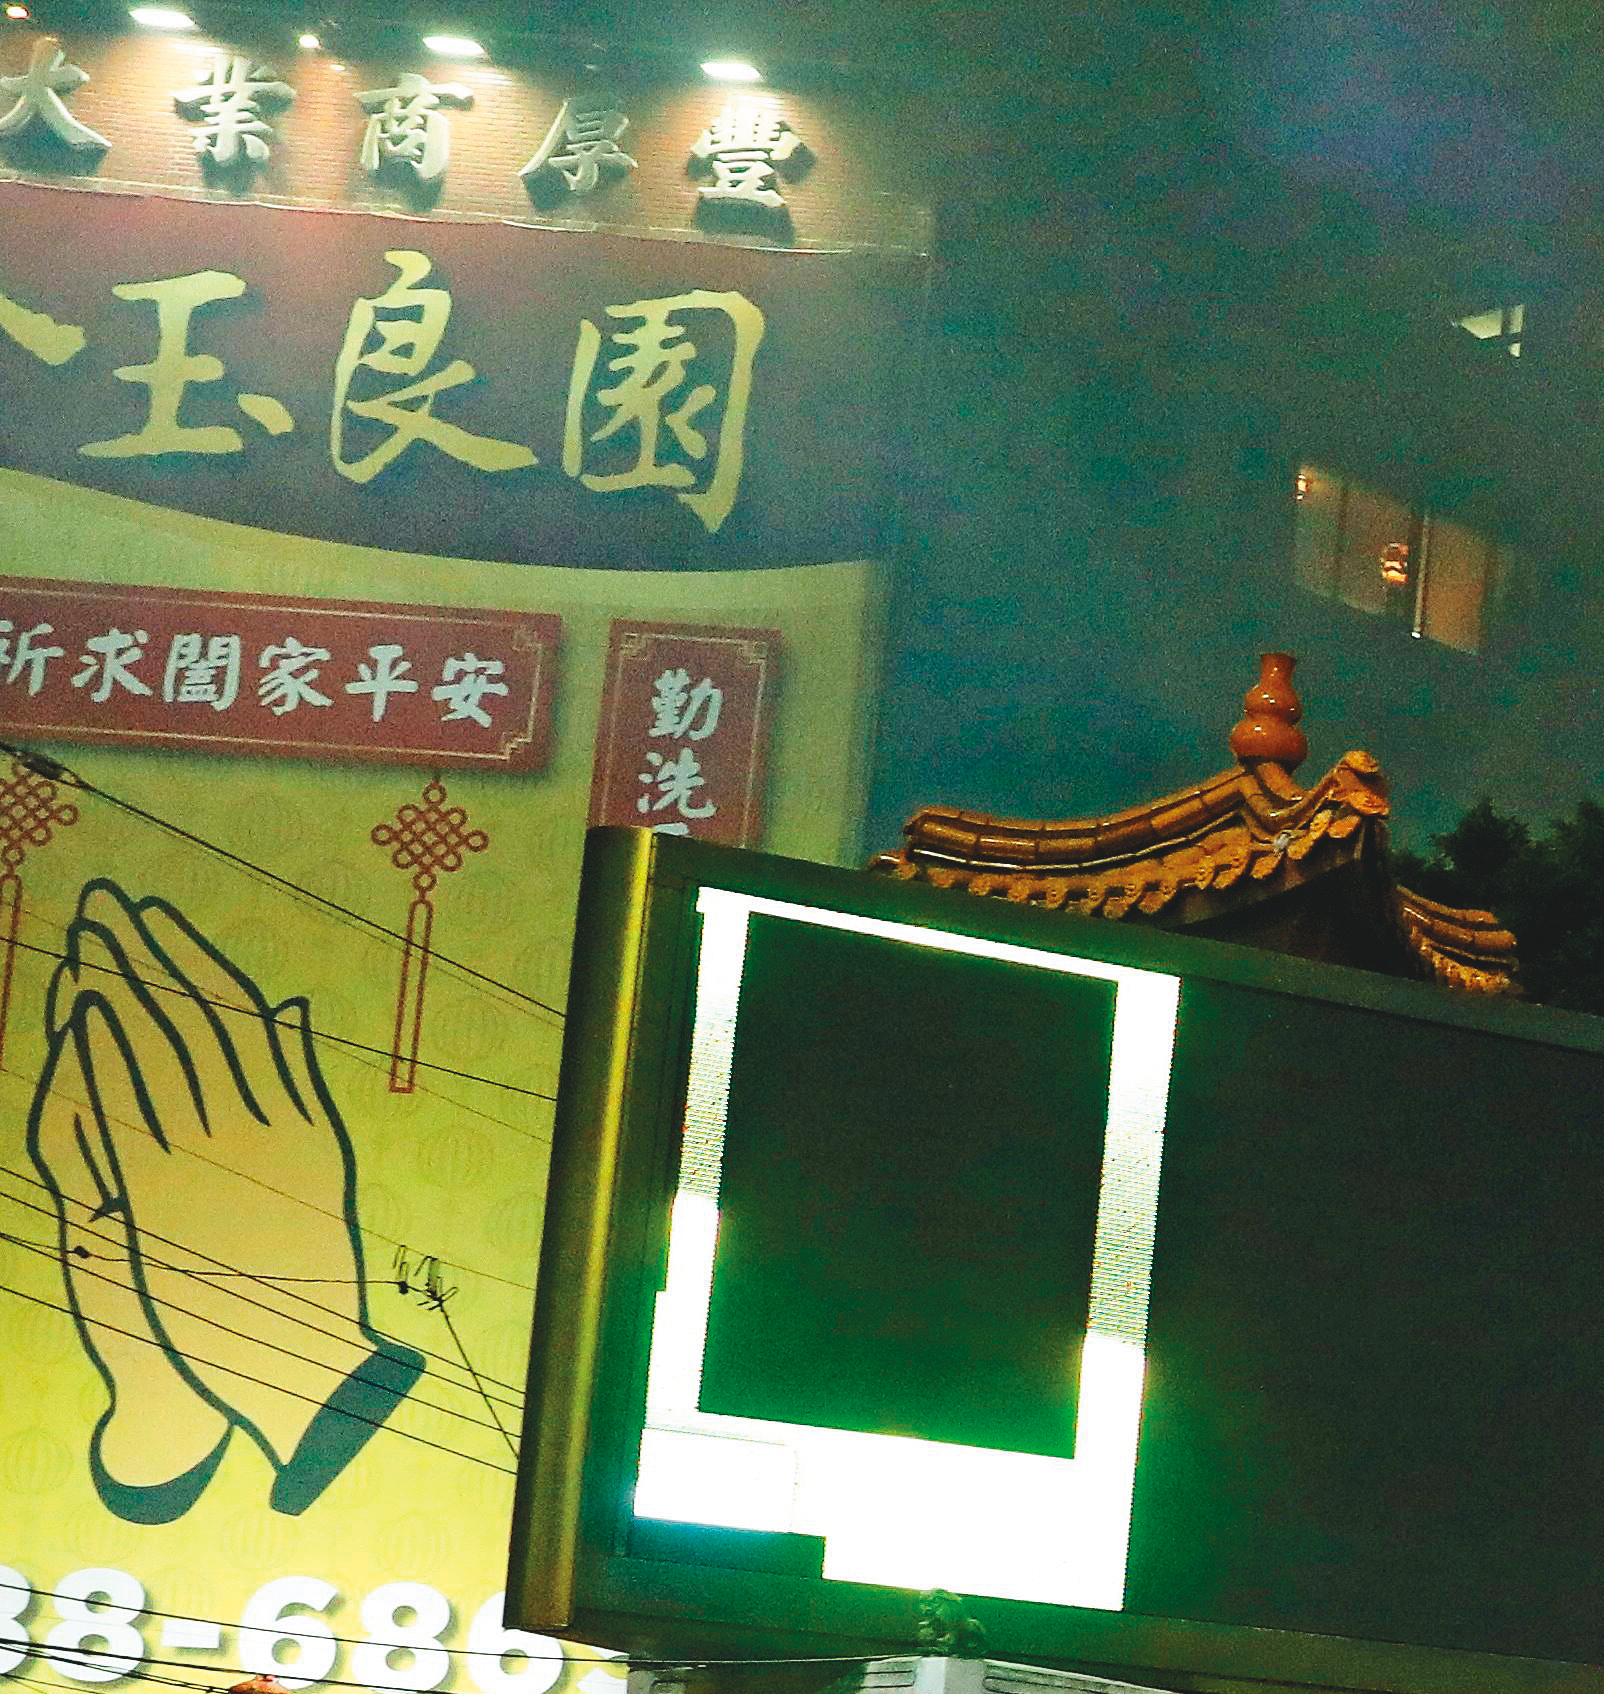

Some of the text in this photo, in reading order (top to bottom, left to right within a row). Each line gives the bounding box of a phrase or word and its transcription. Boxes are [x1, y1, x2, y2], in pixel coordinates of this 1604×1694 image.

[0, 250, 766, 534] 玉良園
[637, 668, 724, 835] 勤洗
